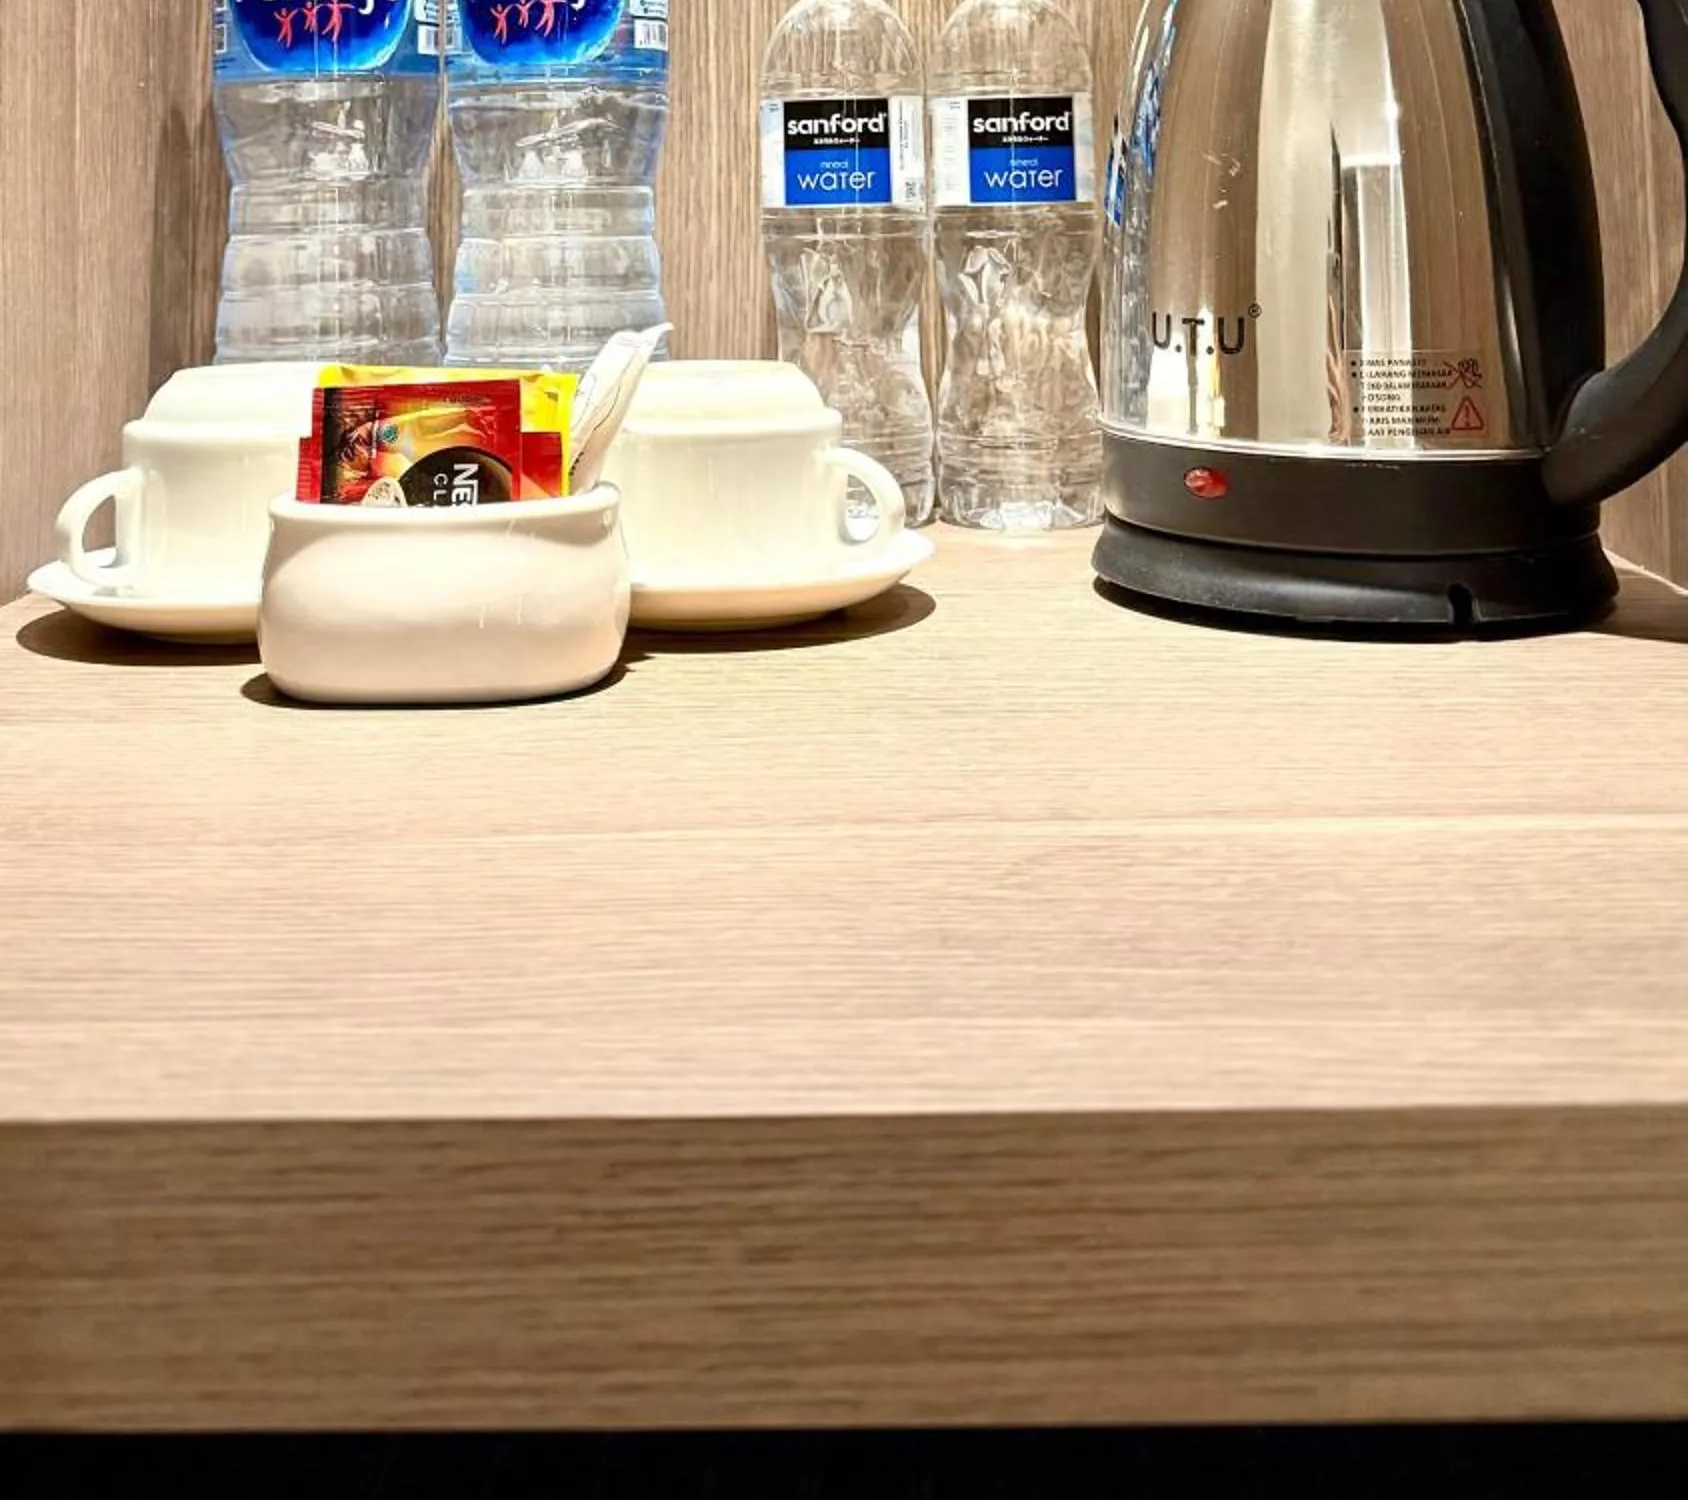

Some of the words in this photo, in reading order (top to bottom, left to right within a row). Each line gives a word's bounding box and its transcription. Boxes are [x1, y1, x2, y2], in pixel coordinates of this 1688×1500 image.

[787, 112, 885, 135] sanford
[973, 111, 1070, 133] sanford
[797, 169, 875, 191] water
[984, 167, 1063, 189] water
